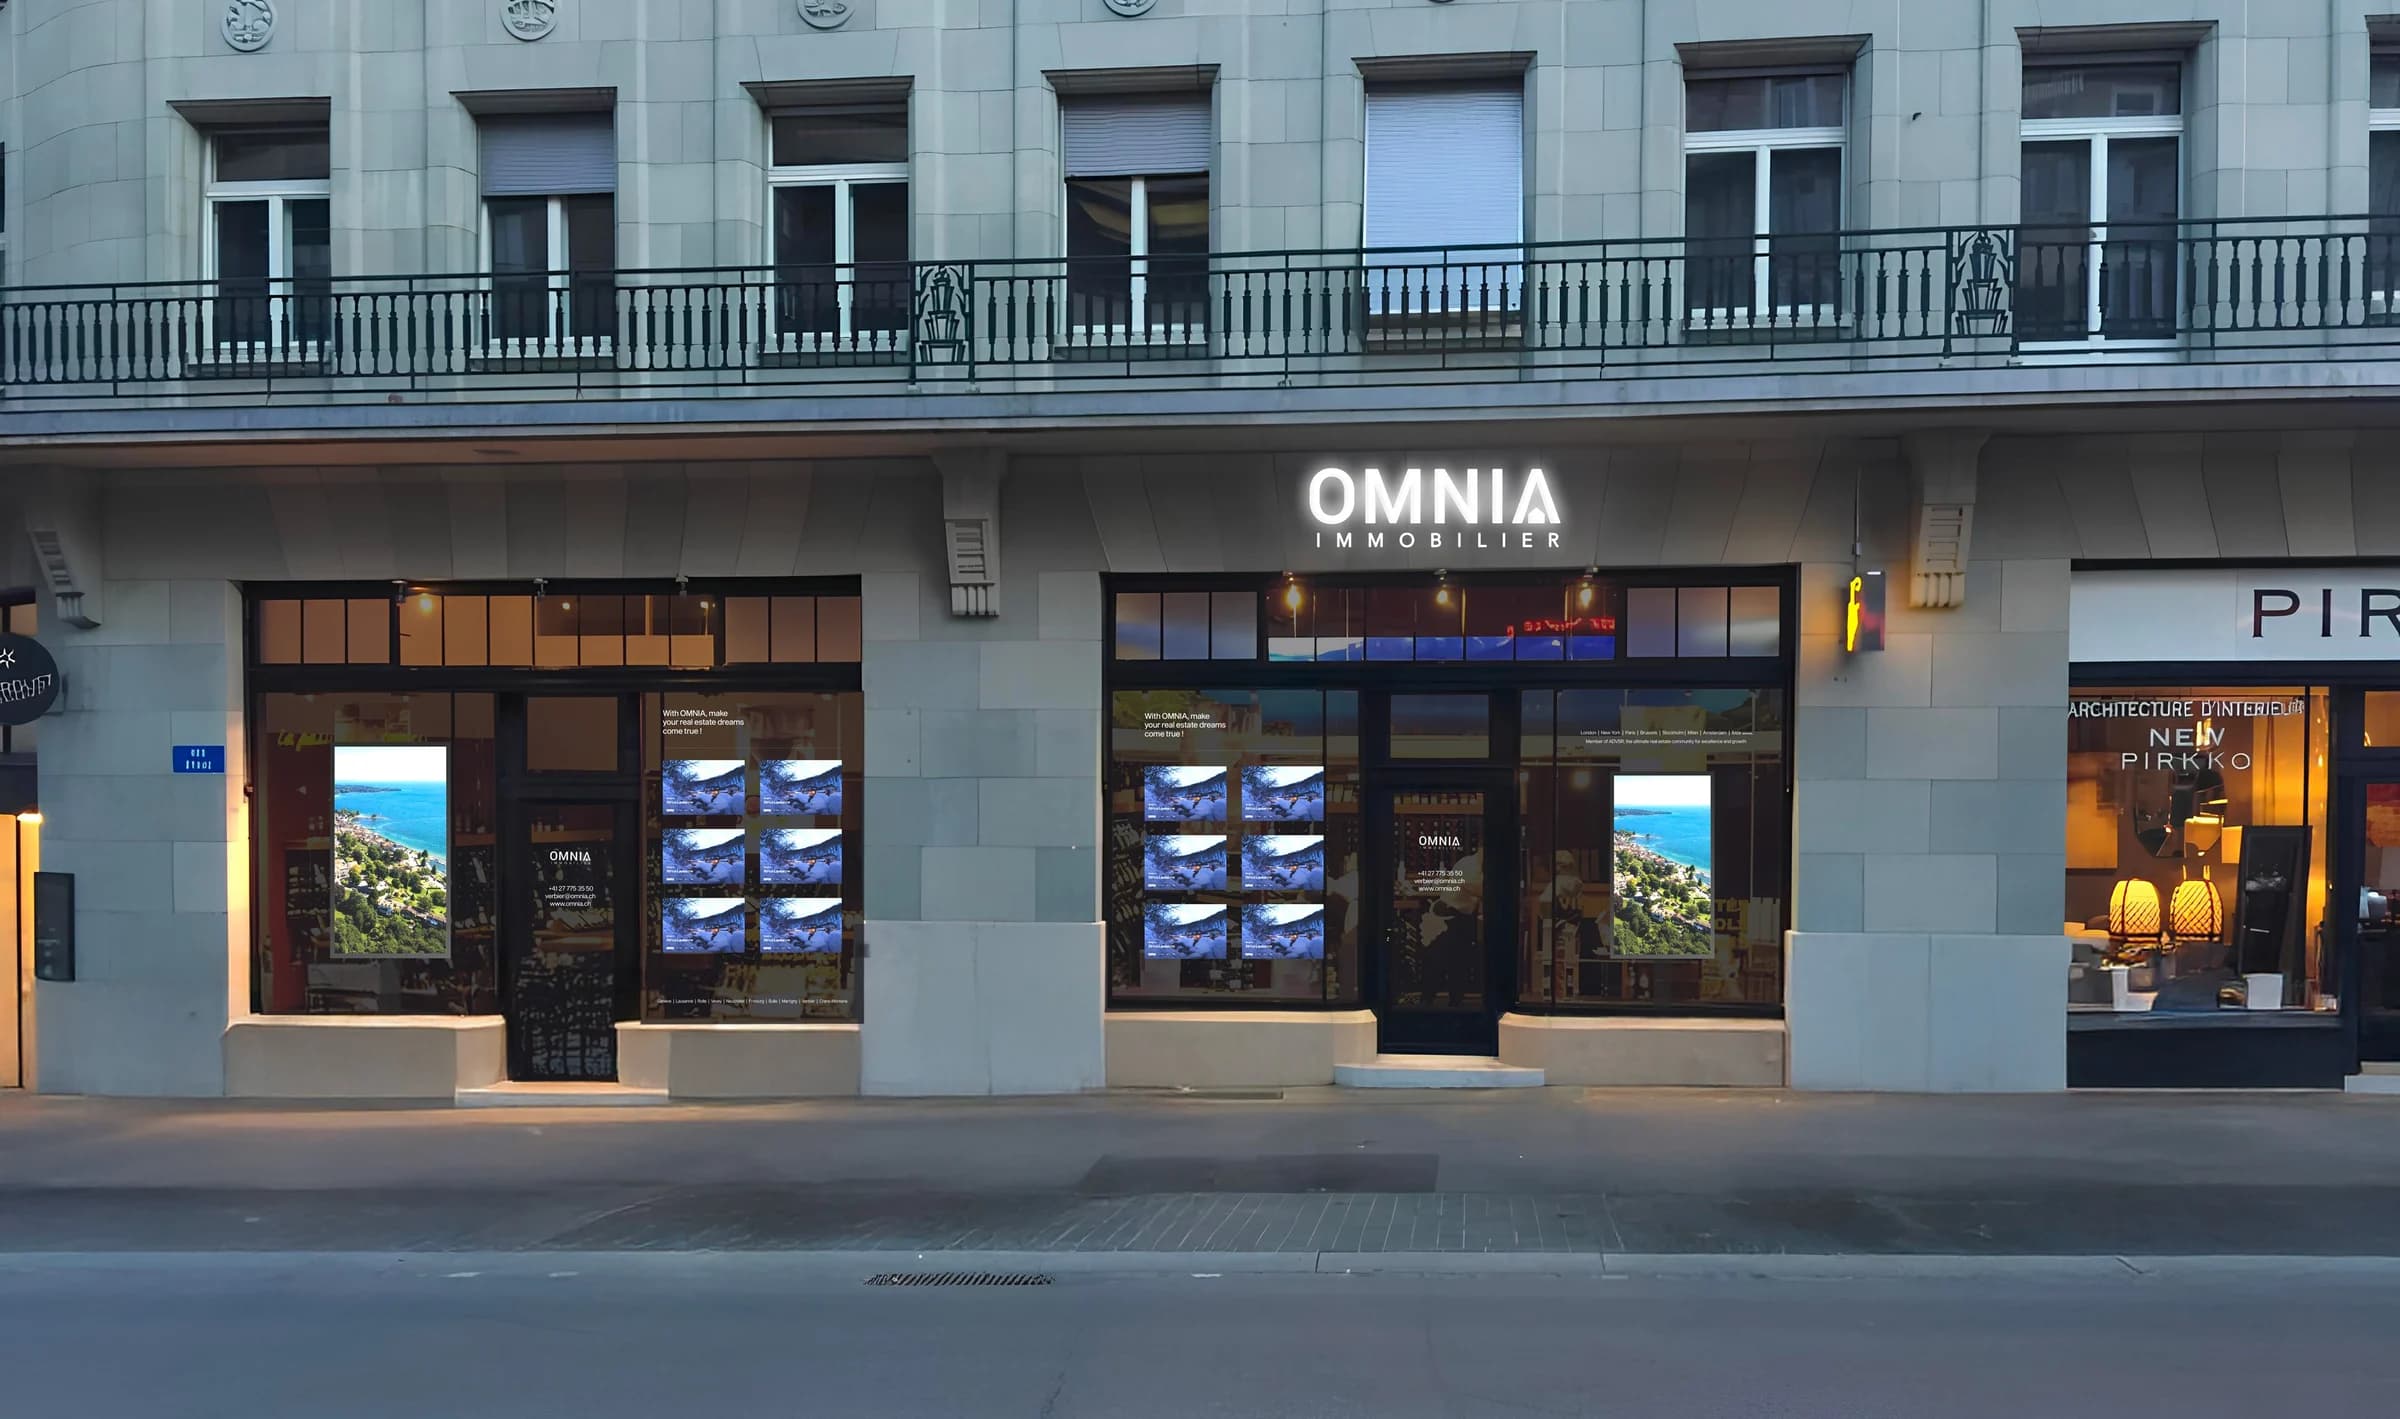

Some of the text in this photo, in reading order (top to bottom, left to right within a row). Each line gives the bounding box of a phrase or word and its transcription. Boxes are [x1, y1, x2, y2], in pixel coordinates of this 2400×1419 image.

[1309, 468, 1561, 525] OMNIA
[1316, 532, 1560, 548] IMMOBILIER
[2253, 588, 2400, 638] PIR
[662, 709, 728, 717] With OMNIA, make
[1144, 712, 1210, 720] With OMNIA, make
[2067, 701, 2193, 719] ARCHITECTURE
[662, 719, 679, 727] your
[1144, 722, 1160, 730] your
[1161, 721, 1175, 729] real
[1199, 721, 1227, 729] dreams
[2150, 727, 2225, 747] NEW
[2121, 752, 2250, 770] PIRKKO
[1418, 835, 1460, 846] OMNIA
[549, 850, 591, 861] OMNIA
